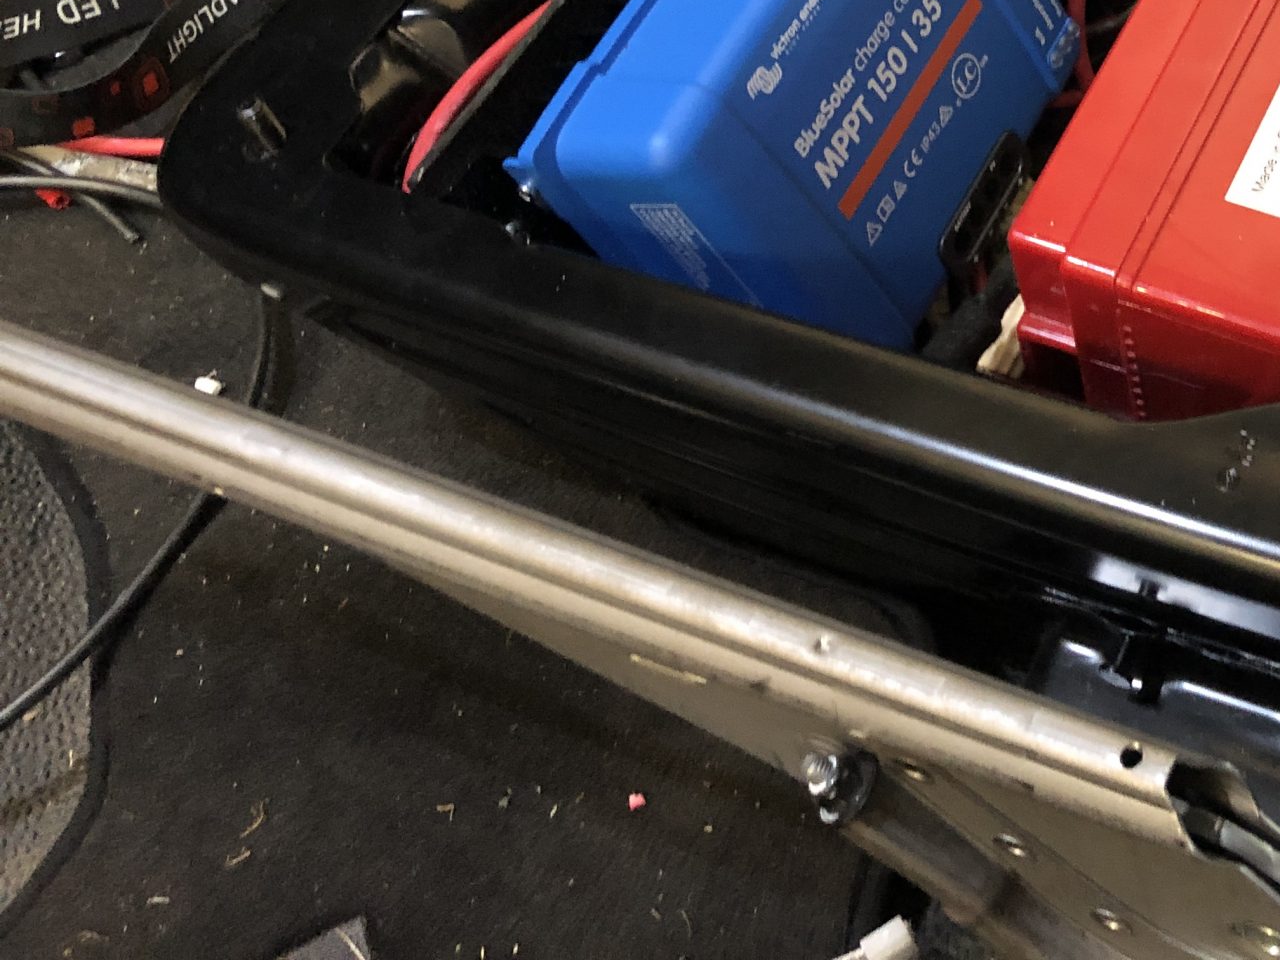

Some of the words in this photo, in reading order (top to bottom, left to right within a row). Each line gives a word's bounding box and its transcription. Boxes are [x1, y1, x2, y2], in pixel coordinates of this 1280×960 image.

[0, 8, 41, 40] HE
[794, 68, 856, 158] BlueSolar
[855, 10, 896, 72] charge
[815, 94, 874, 189] MPPT
[868, 46, 908, 102] 150
